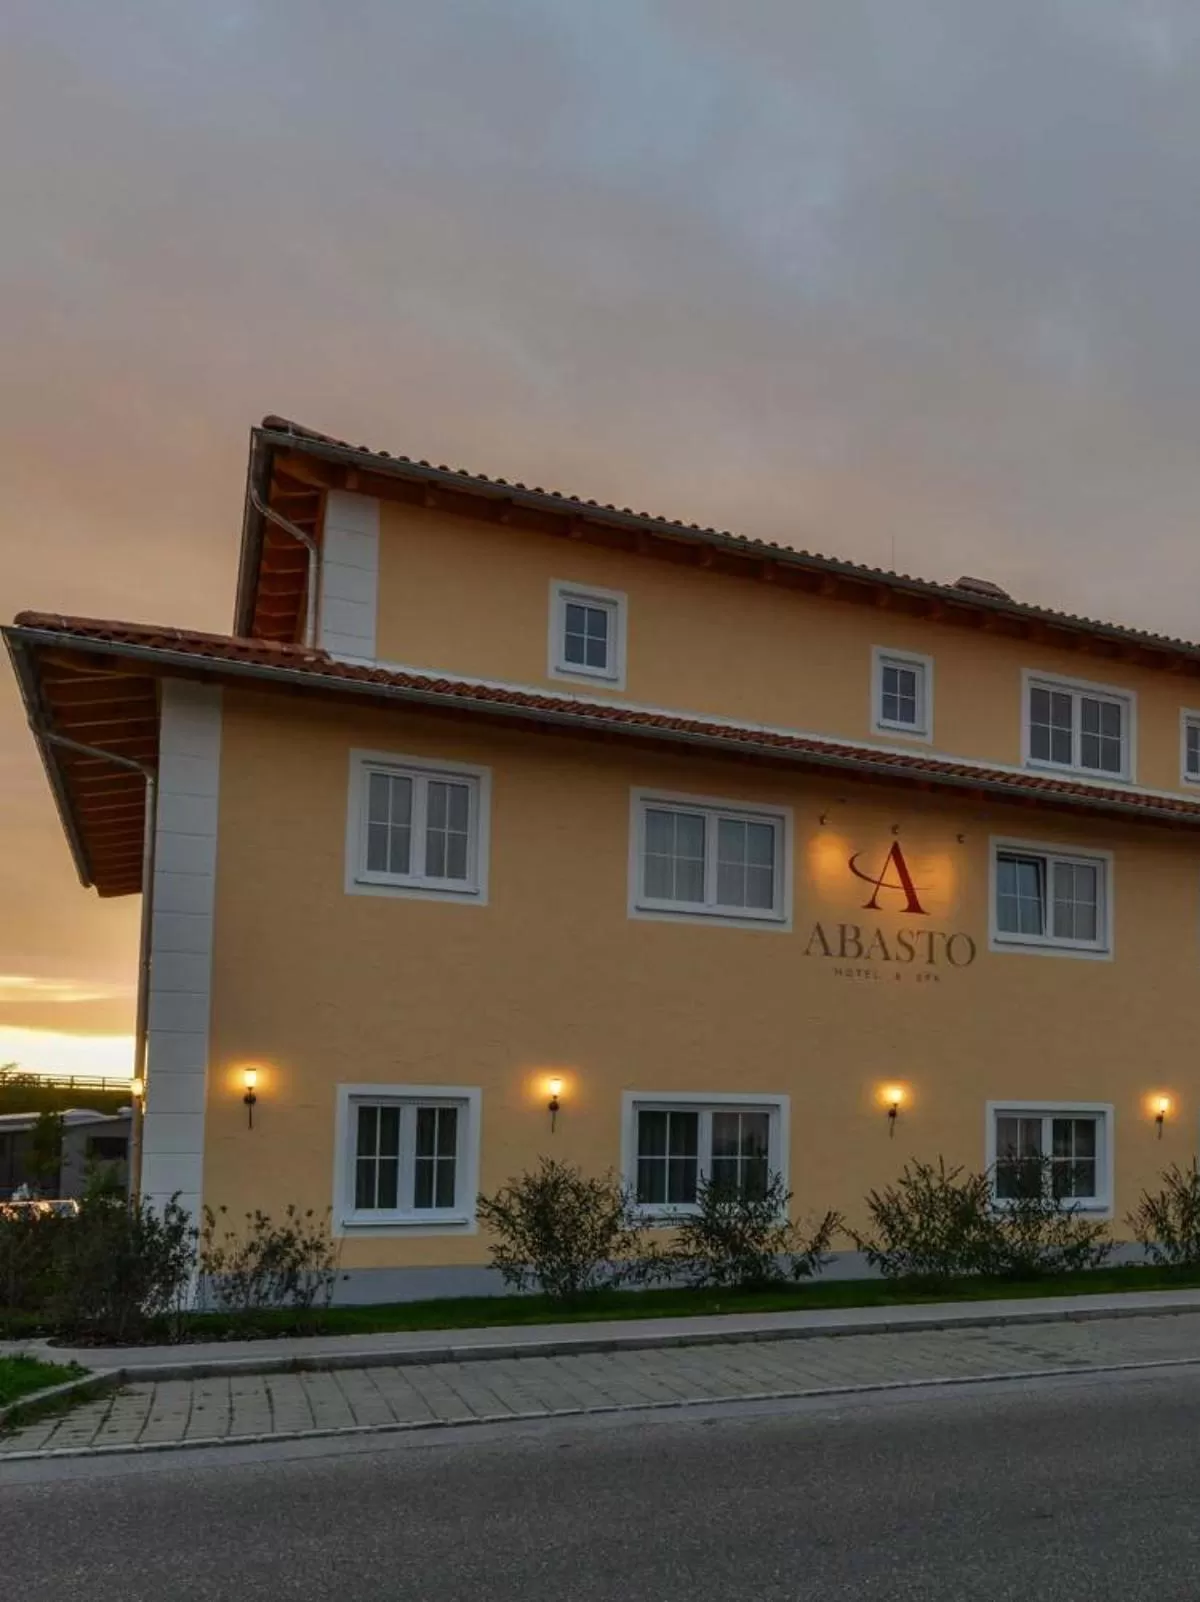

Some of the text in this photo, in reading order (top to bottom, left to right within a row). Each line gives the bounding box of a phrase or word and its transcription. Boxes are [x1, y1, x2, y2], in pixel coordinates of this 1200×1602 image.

[849, 840, 932, 915] A
[803, 922, 976, 967] ABASTO
[834, 967, 881, 981] HOTEL
